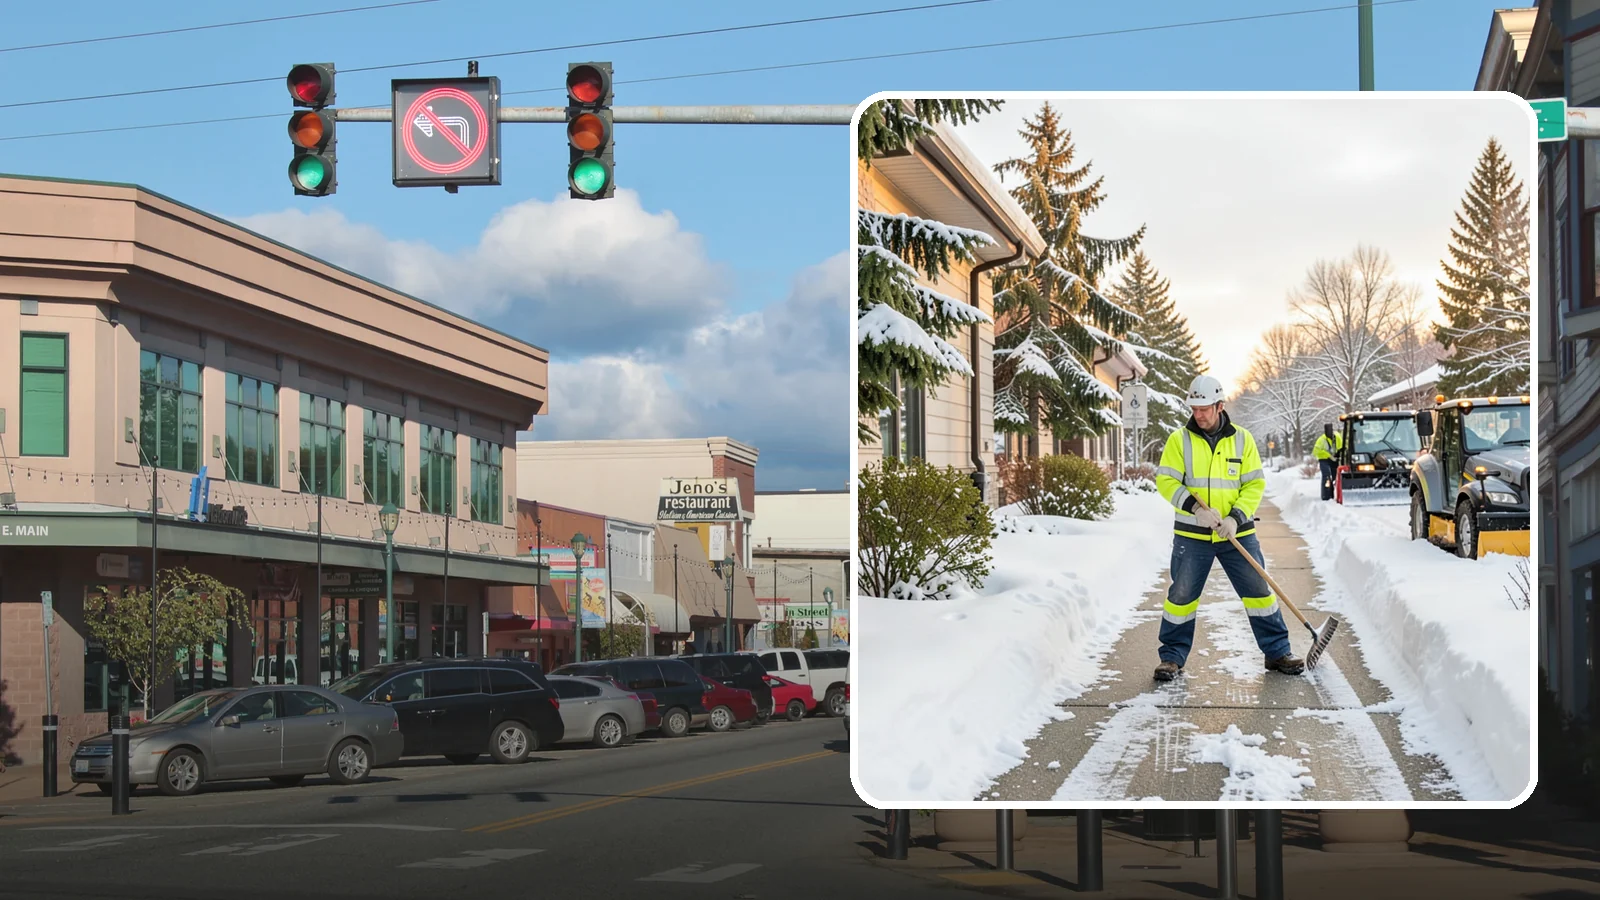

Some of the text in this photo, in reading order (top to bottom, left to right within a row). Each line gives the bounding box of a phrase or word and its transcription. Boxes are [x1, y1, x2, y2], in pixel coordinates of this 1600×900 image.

[670, 480, 727, 494] Jeno's
[665, 497, 731, 509] restaurant
[686, 510, 714, 519] American
[715, 510, 737, 519] Cuisine
[2, 525, 49, 536] E. MAIN
[797, 607, 829, 617] Street
